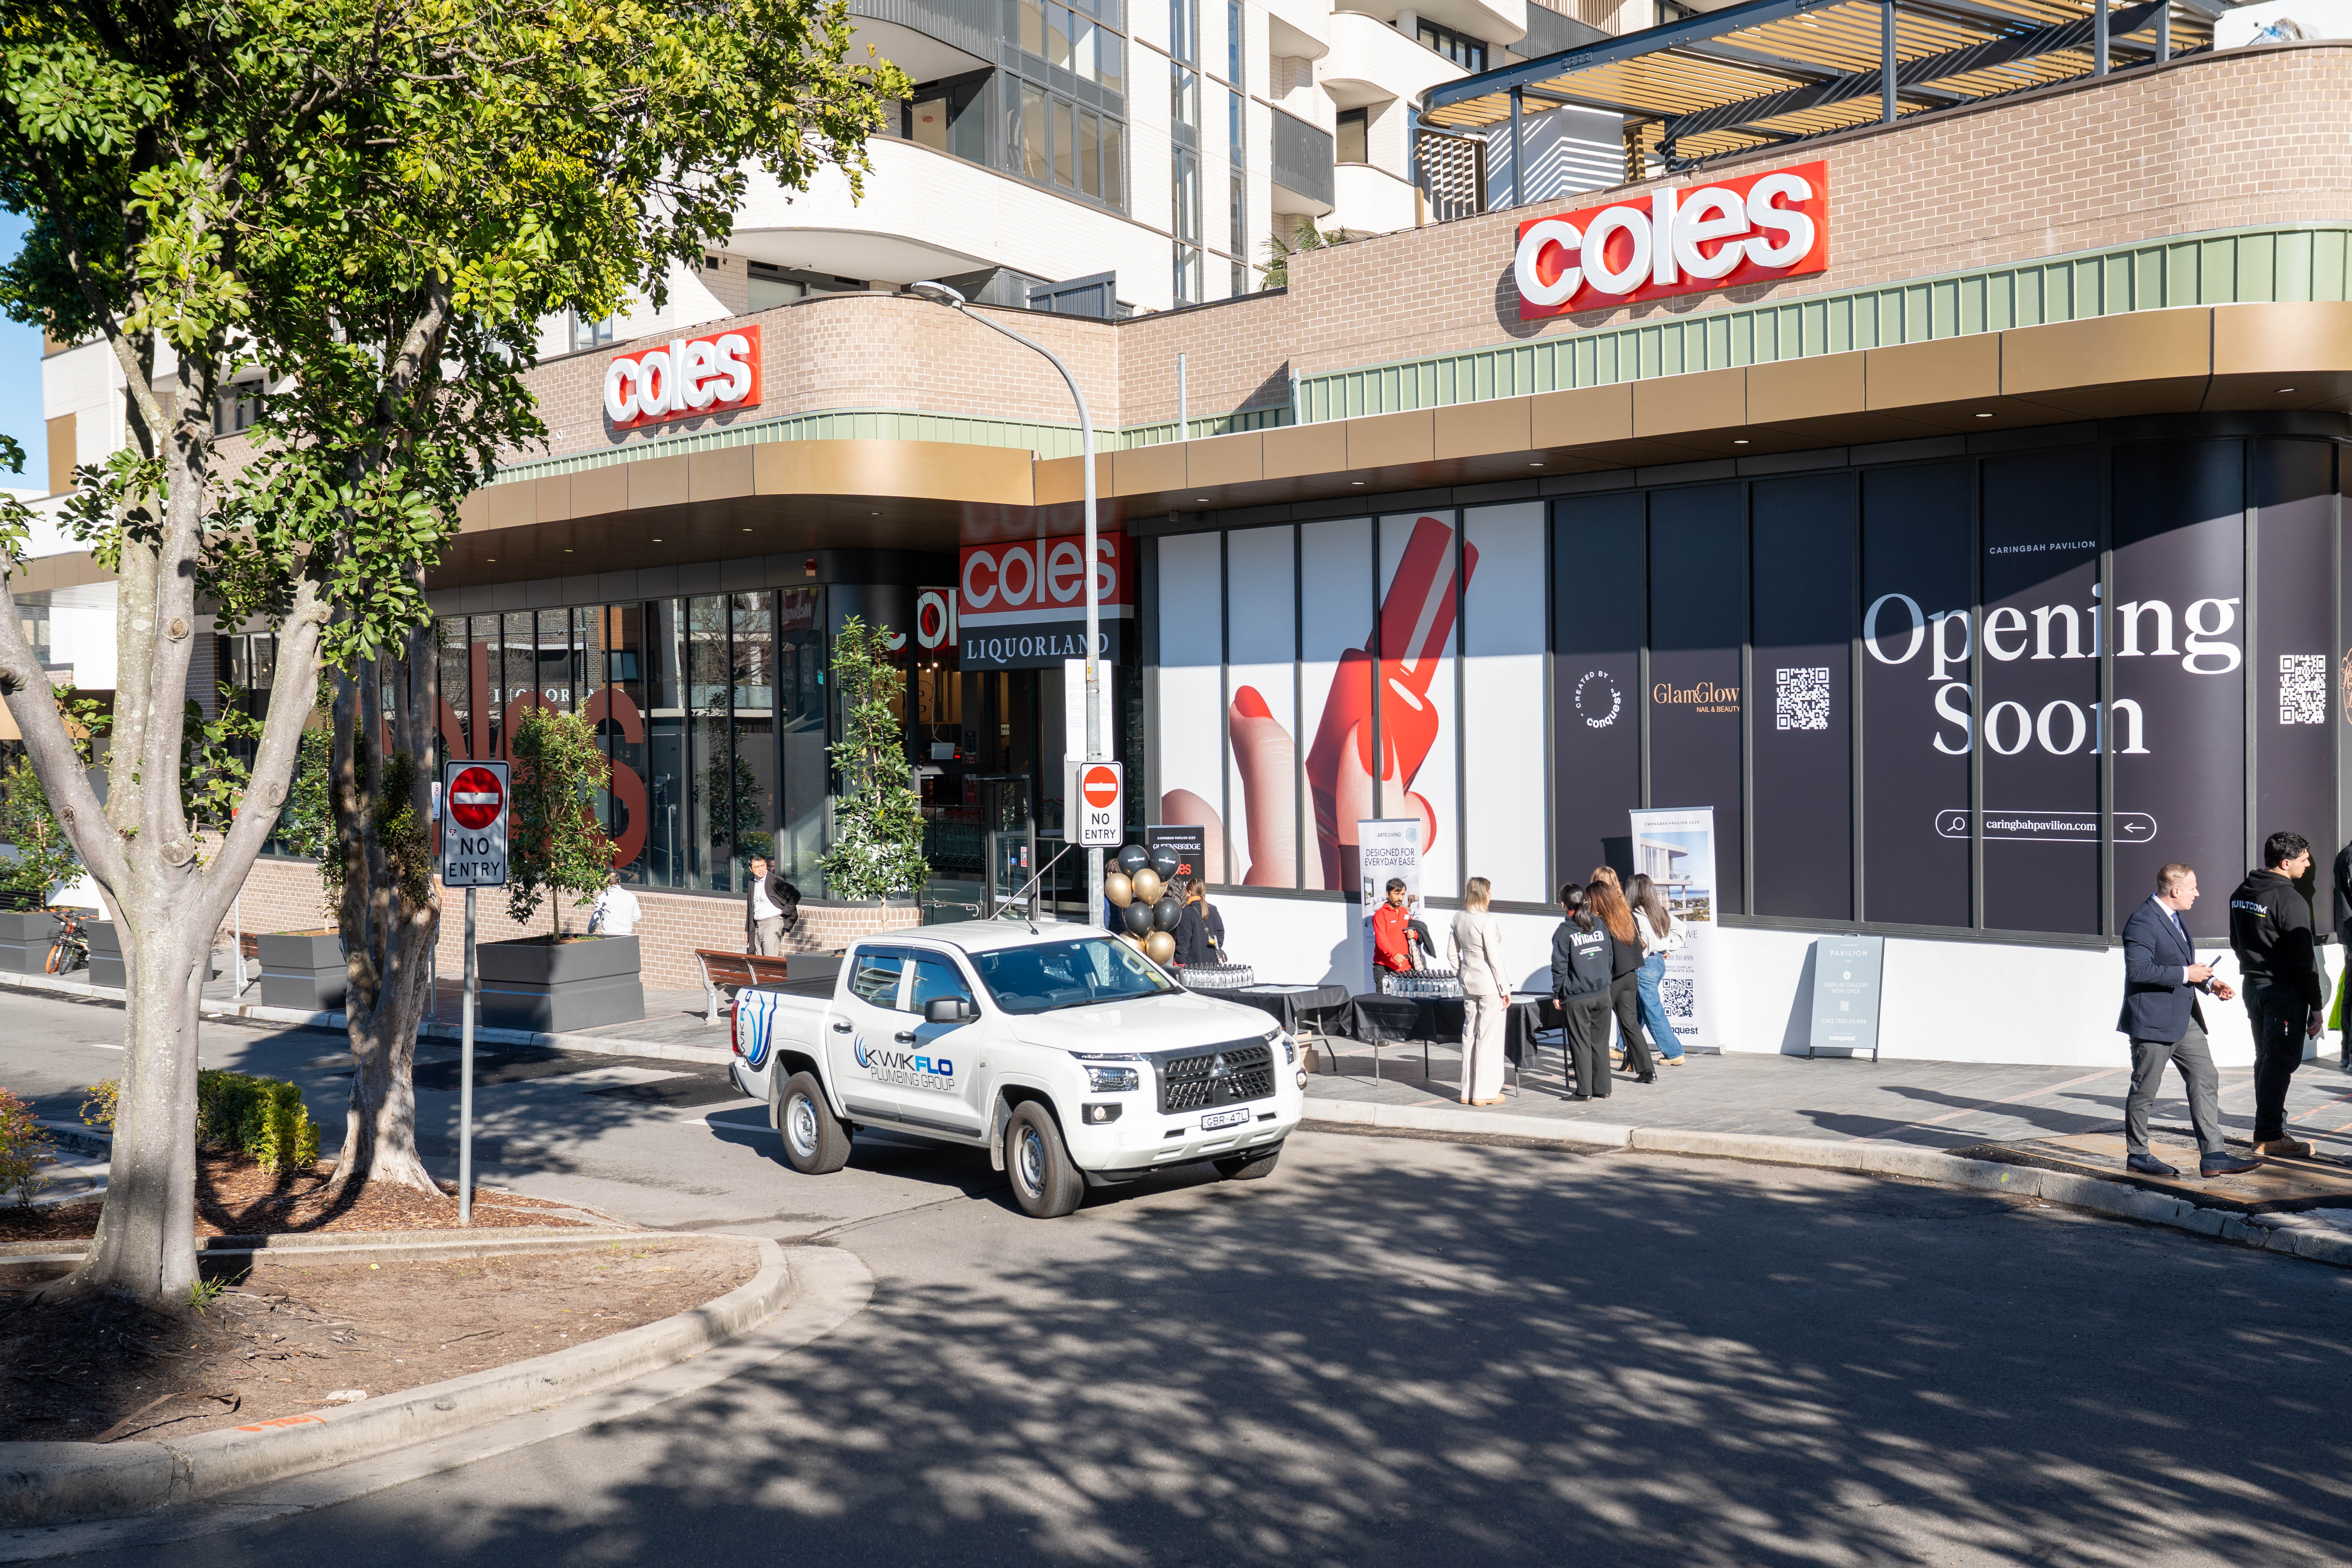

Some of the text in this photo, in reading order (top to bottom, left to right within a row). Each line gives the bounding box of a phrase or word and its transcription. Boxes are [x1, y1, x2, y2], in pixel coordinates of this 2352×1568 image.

[1515, 173, 1814, 306] coles
[604, 334, 751, 421] coles
[1990, 541, 2095, 554] CARINGBAH PAVILION
[963, 539, 1116, 608] coles
[1863, 583, 2241, 680] Opening
[967, 633, 1109, 663] LIQUORLAND
[1575, 672, 1594, 708] CREATED
[1586, 691, 1621, 728] conquest
[1933, 683, 2150, 754] Soon
[1092, 813, 1109, 825] NO
[1986, 820, 2096, 831] caringbahpavilion.com
[461, 838, 489, 855] NO
[1086, 829, 1116, 839] ENTRY
[449, 862, 500, 877] ENTRY
[865, 1048, 953, 1076] KWIKFLO
[871, 1067, 955, 1091] PLUMBING GROUP
